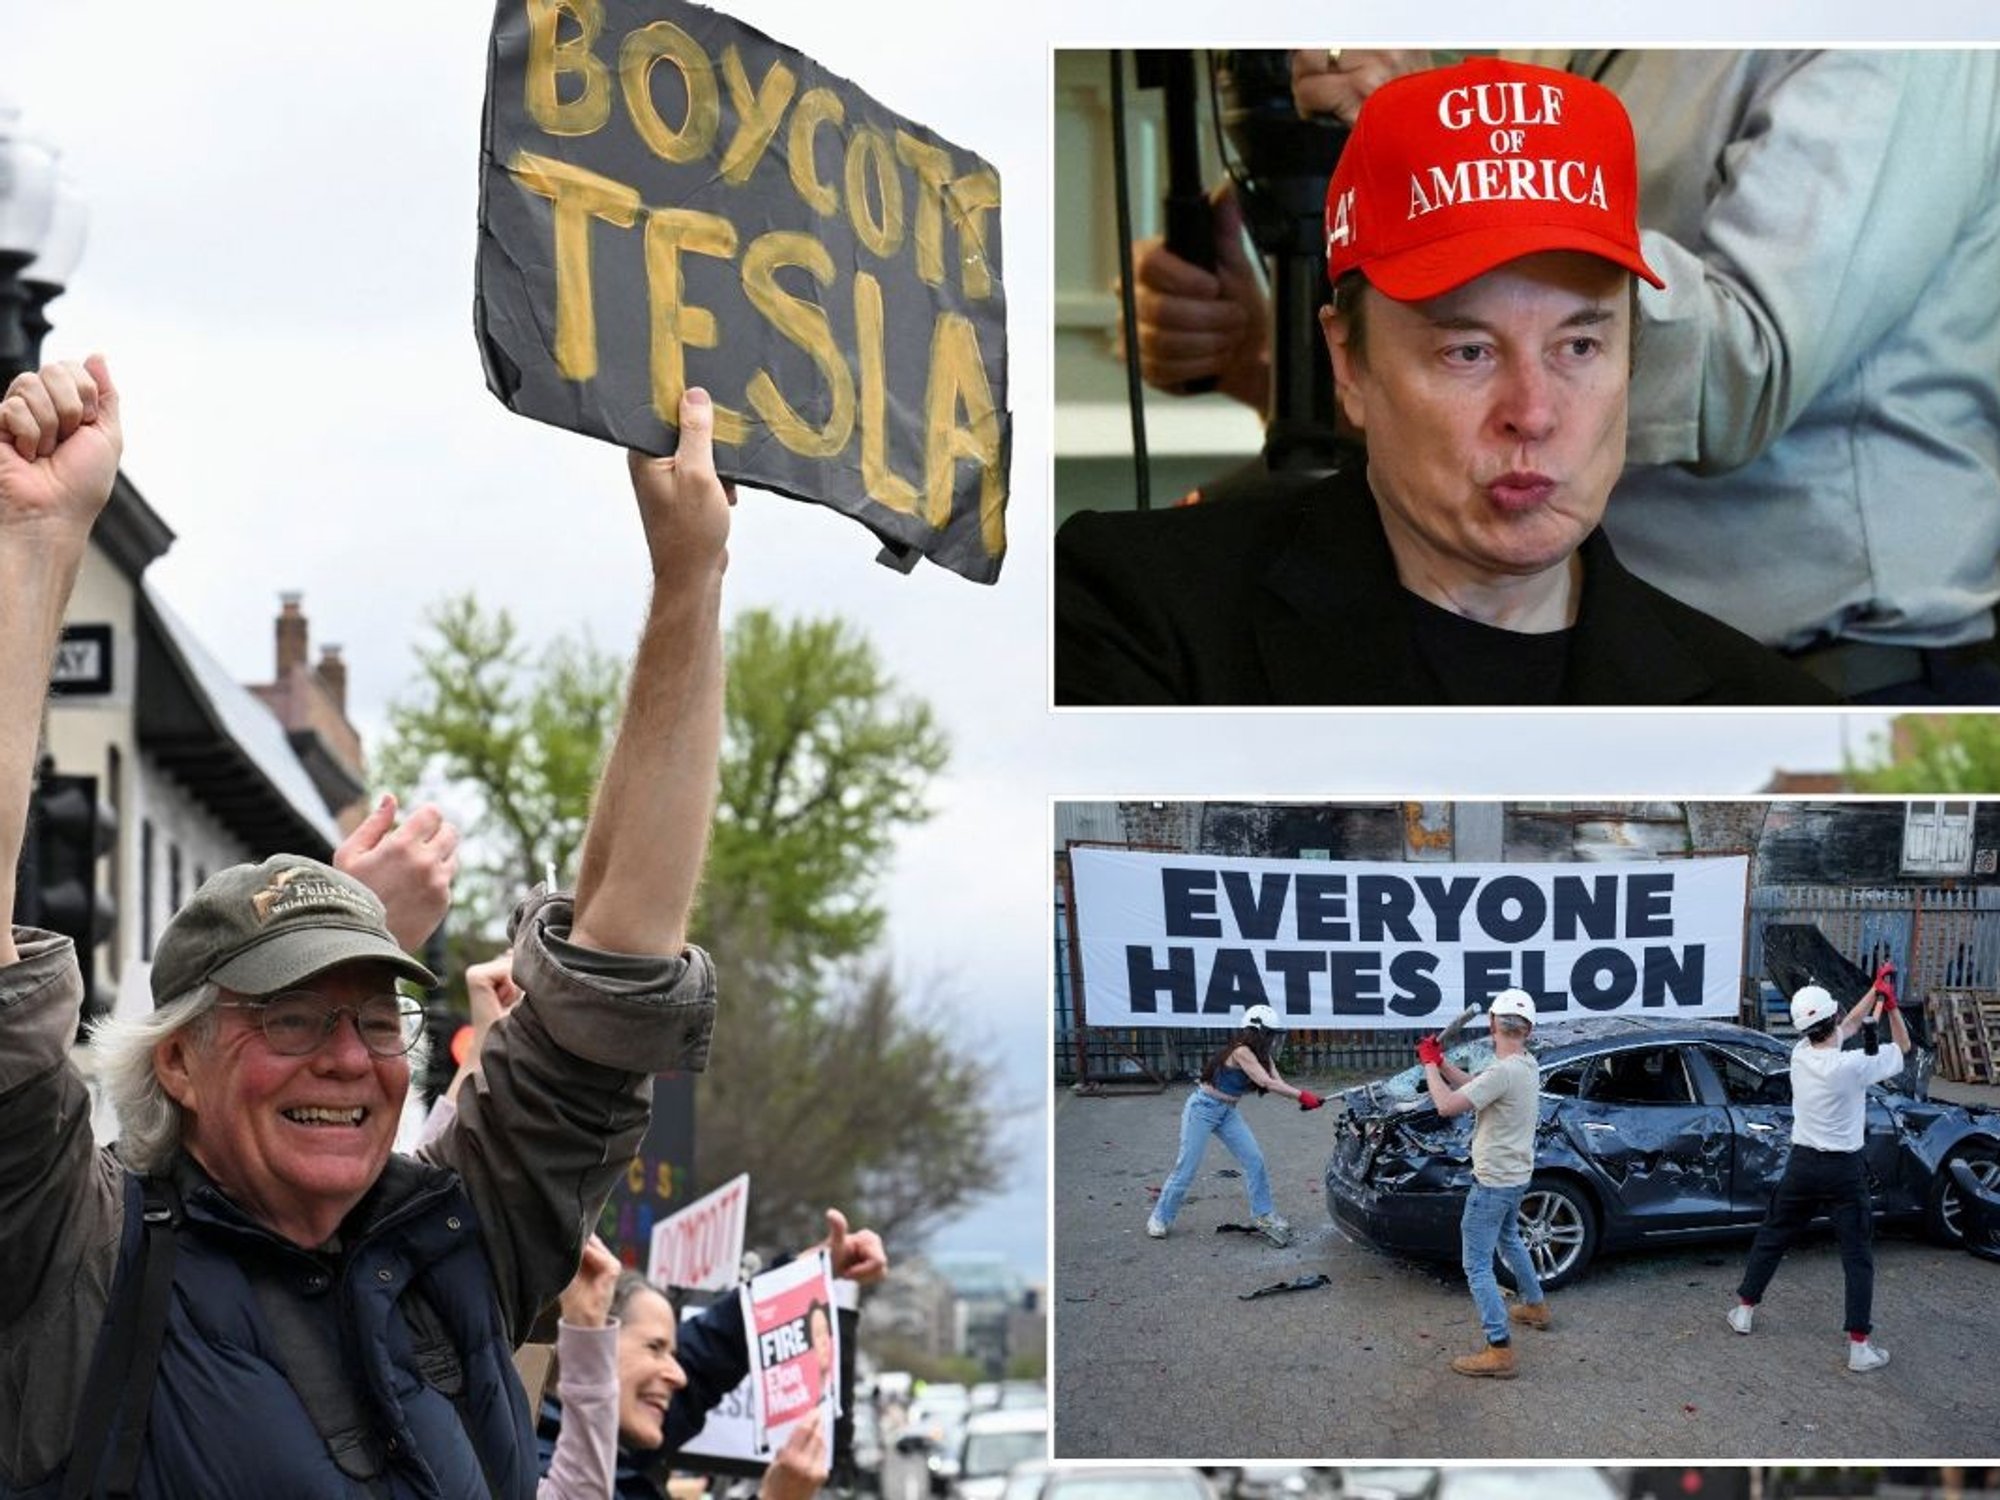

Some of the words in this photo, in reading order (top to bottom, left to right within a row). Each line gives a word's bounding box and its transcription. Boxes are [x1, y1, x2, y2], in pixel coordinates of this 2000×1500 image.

[1438, 82, 1564, 130] GULF
[524, 0, 1001, 299] BOYCOTT
[1489, 129, 1526, 154] OF
[1407, 158, 1609, 221] AMERICA
[508, 148, 1007, 556] TESLA
[1162, 867, 1675, 943] EVERYONE
[1126, 944, 1442, 1018] HATES
[1463, 943, 1706, 1012] ELON
[760, 1318, 809, 1368] FIRE
